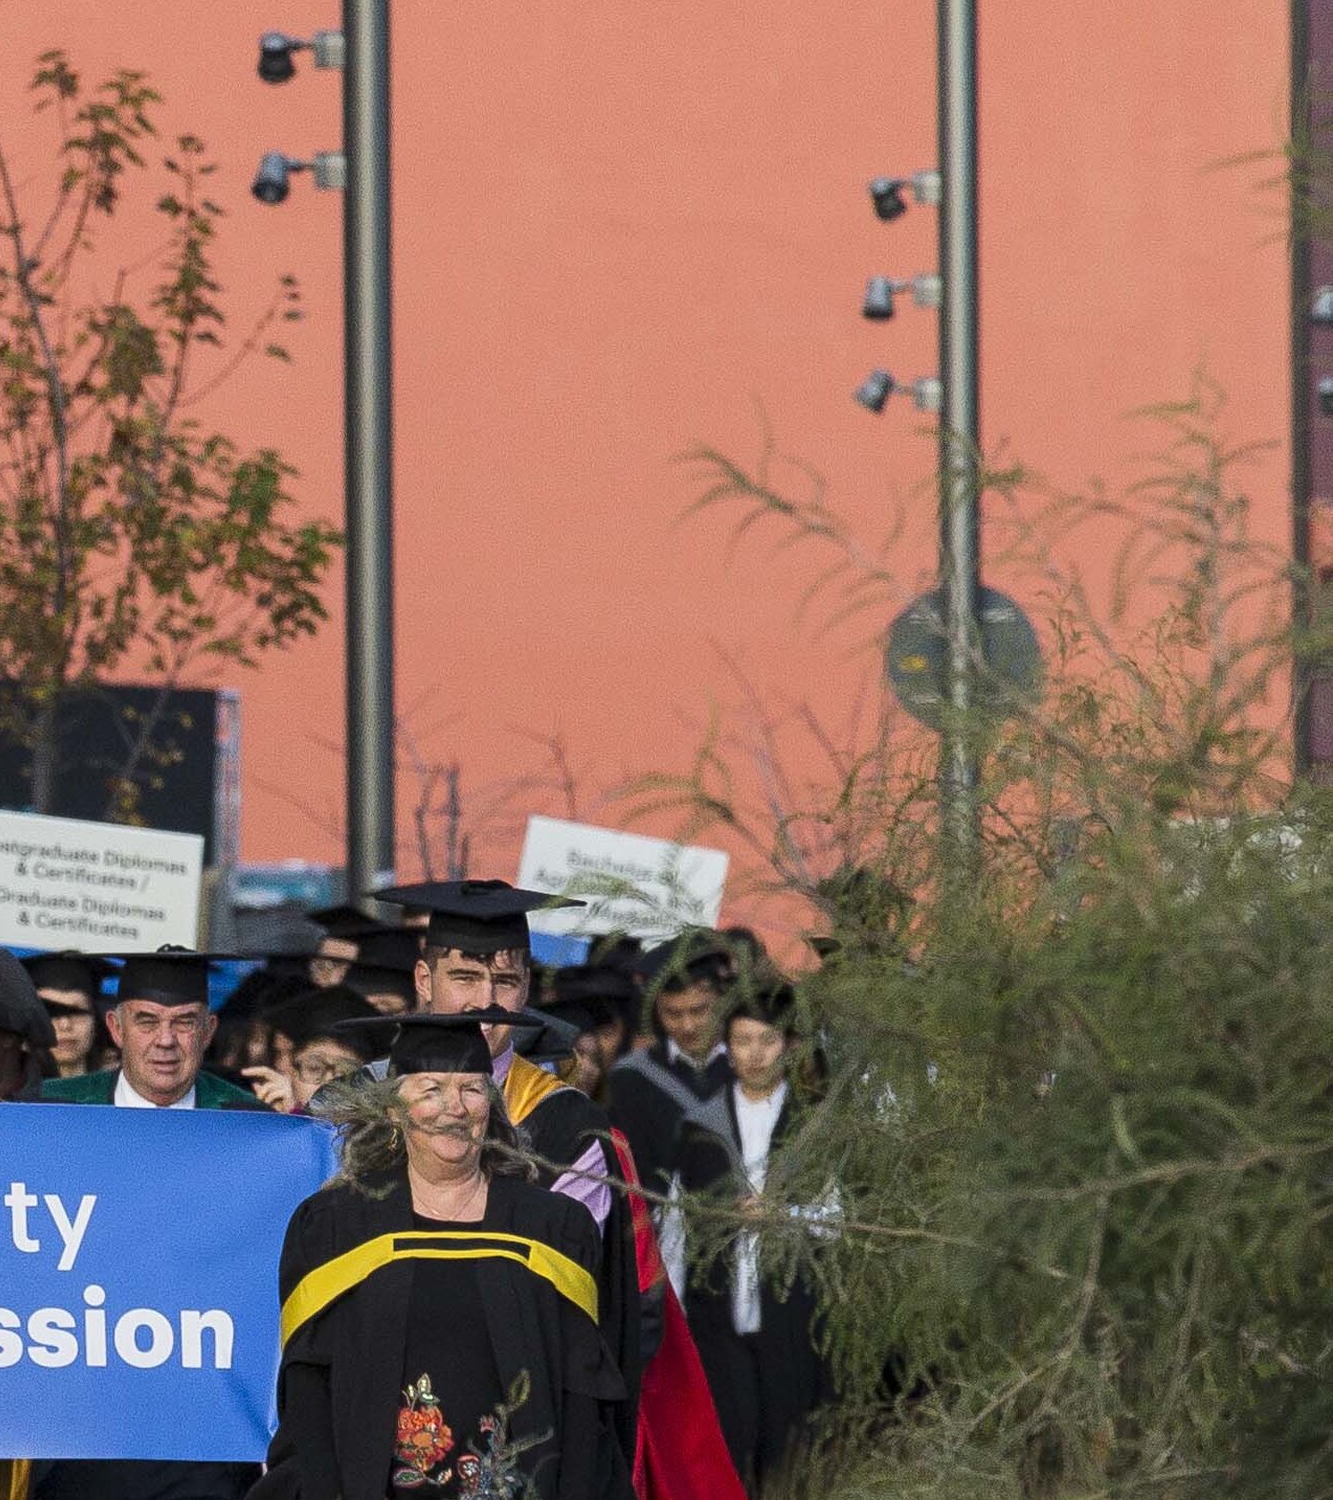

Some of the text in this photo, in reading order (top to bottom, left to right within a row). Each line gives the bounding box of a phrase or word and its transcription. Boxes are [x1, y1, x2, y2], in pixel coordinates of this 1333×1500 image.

[33, 861, 138, 889] Certificates
[103, 850, 188, 876] Diplomas
[81, 898, 168, 923] Diplomas
[33, 911, 140, 940] Certificates
